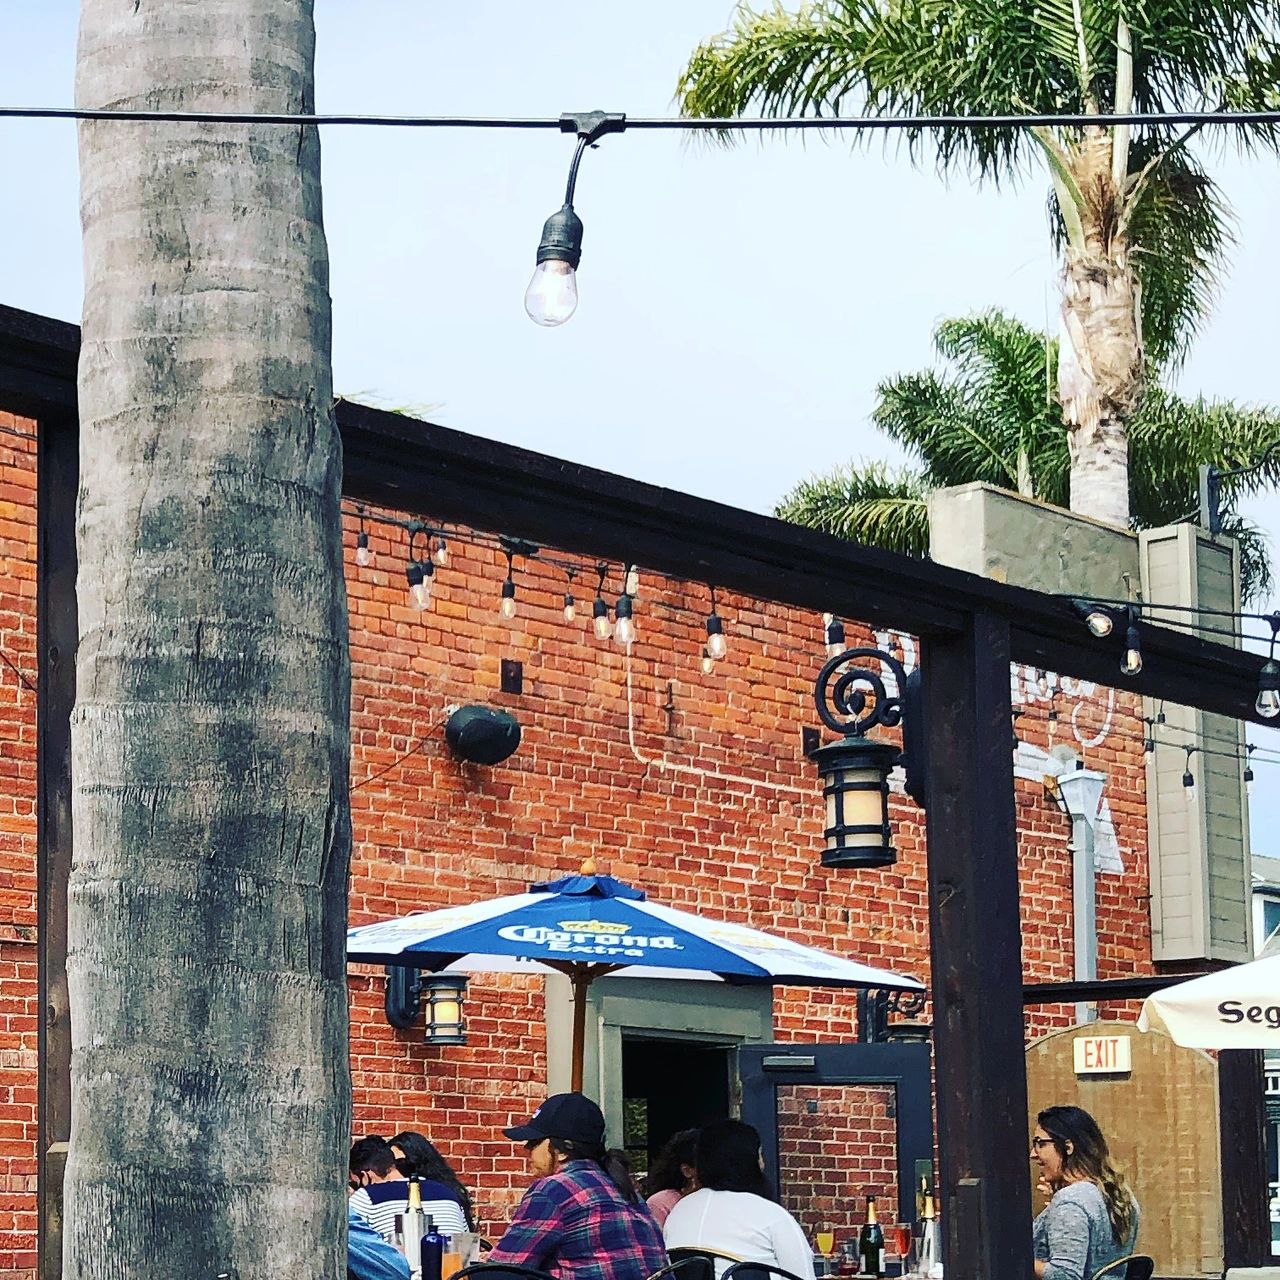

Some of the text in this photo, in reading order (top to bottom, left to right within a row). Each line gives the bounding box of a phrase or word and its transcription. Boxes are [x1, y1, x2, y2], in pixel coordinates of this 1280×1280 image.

[497, 925, 684, 950] Corona
[547, 941, 644, 957] Extra
[1084, 1039, 1119, 1069] EXIT
